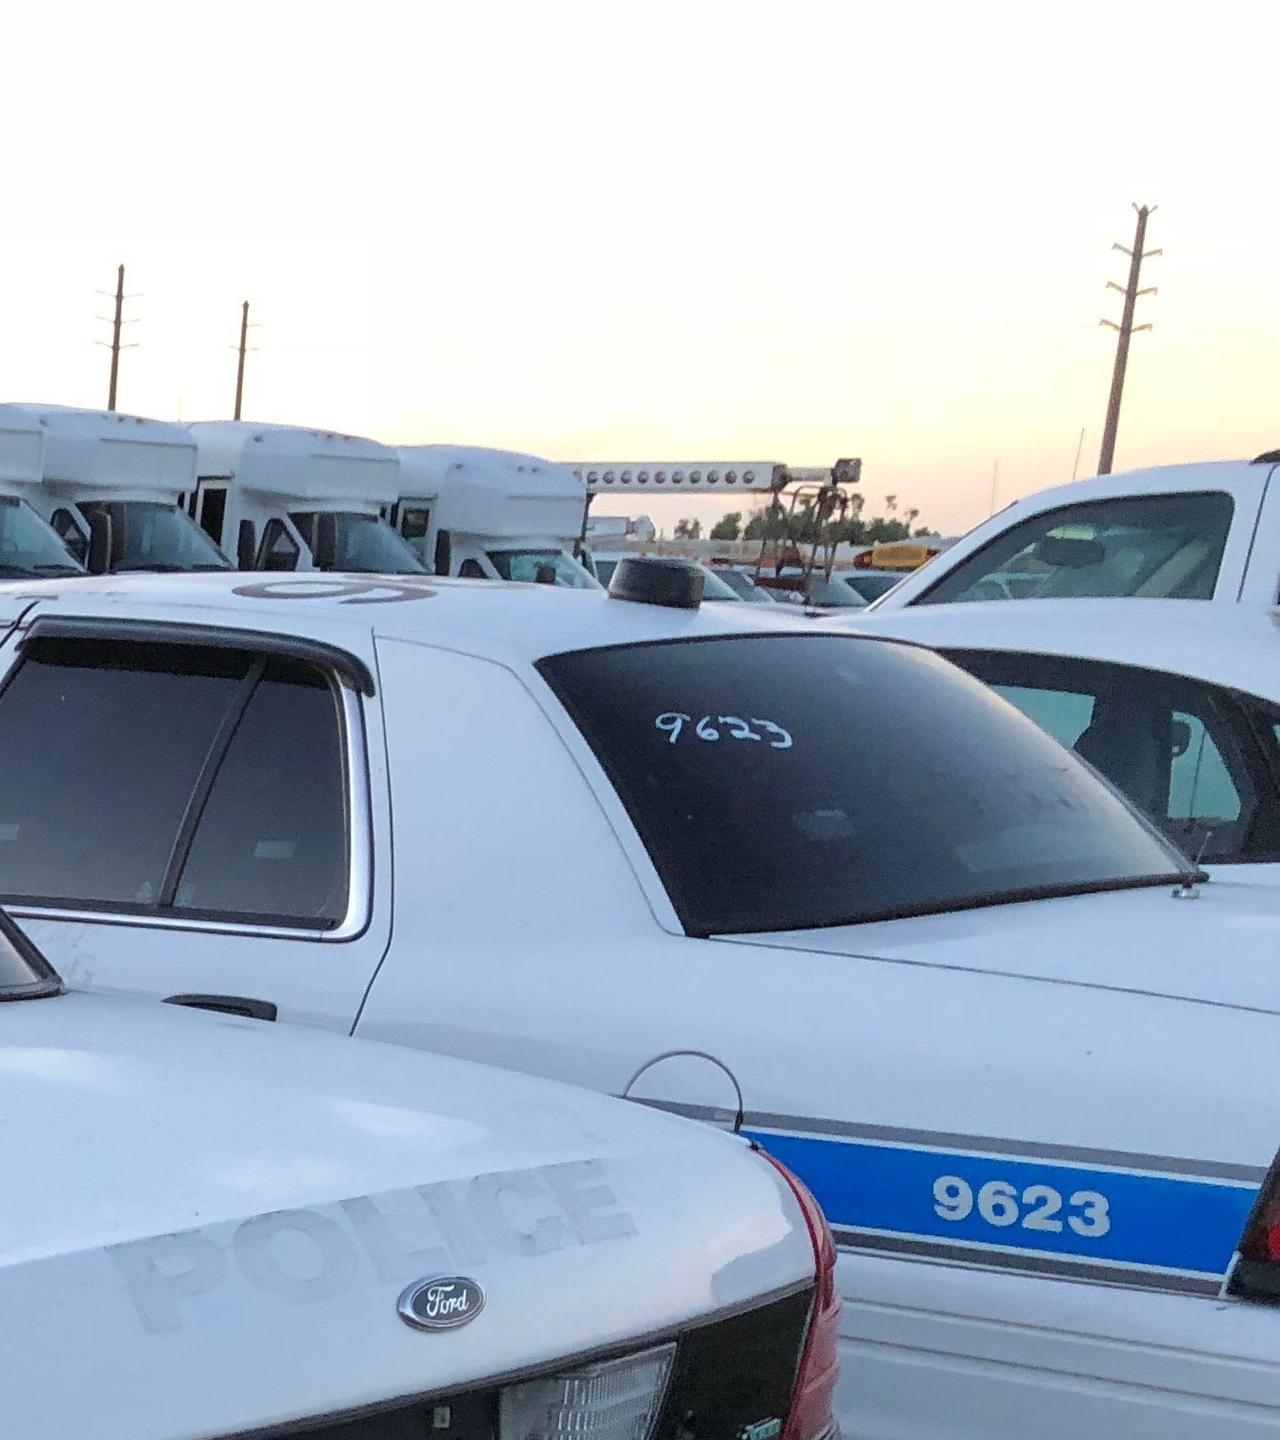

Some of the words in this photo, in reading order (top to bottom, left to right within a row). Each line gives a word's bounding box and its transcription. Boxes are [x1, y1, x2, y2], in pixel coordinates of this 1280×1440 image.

[655, 712, 793, 749] 9623
[932, 1174, 1111, 1237] 9623
[104, 1157, 638, 1333] POLICE
[426, 1284, 470, 1317] Ford
